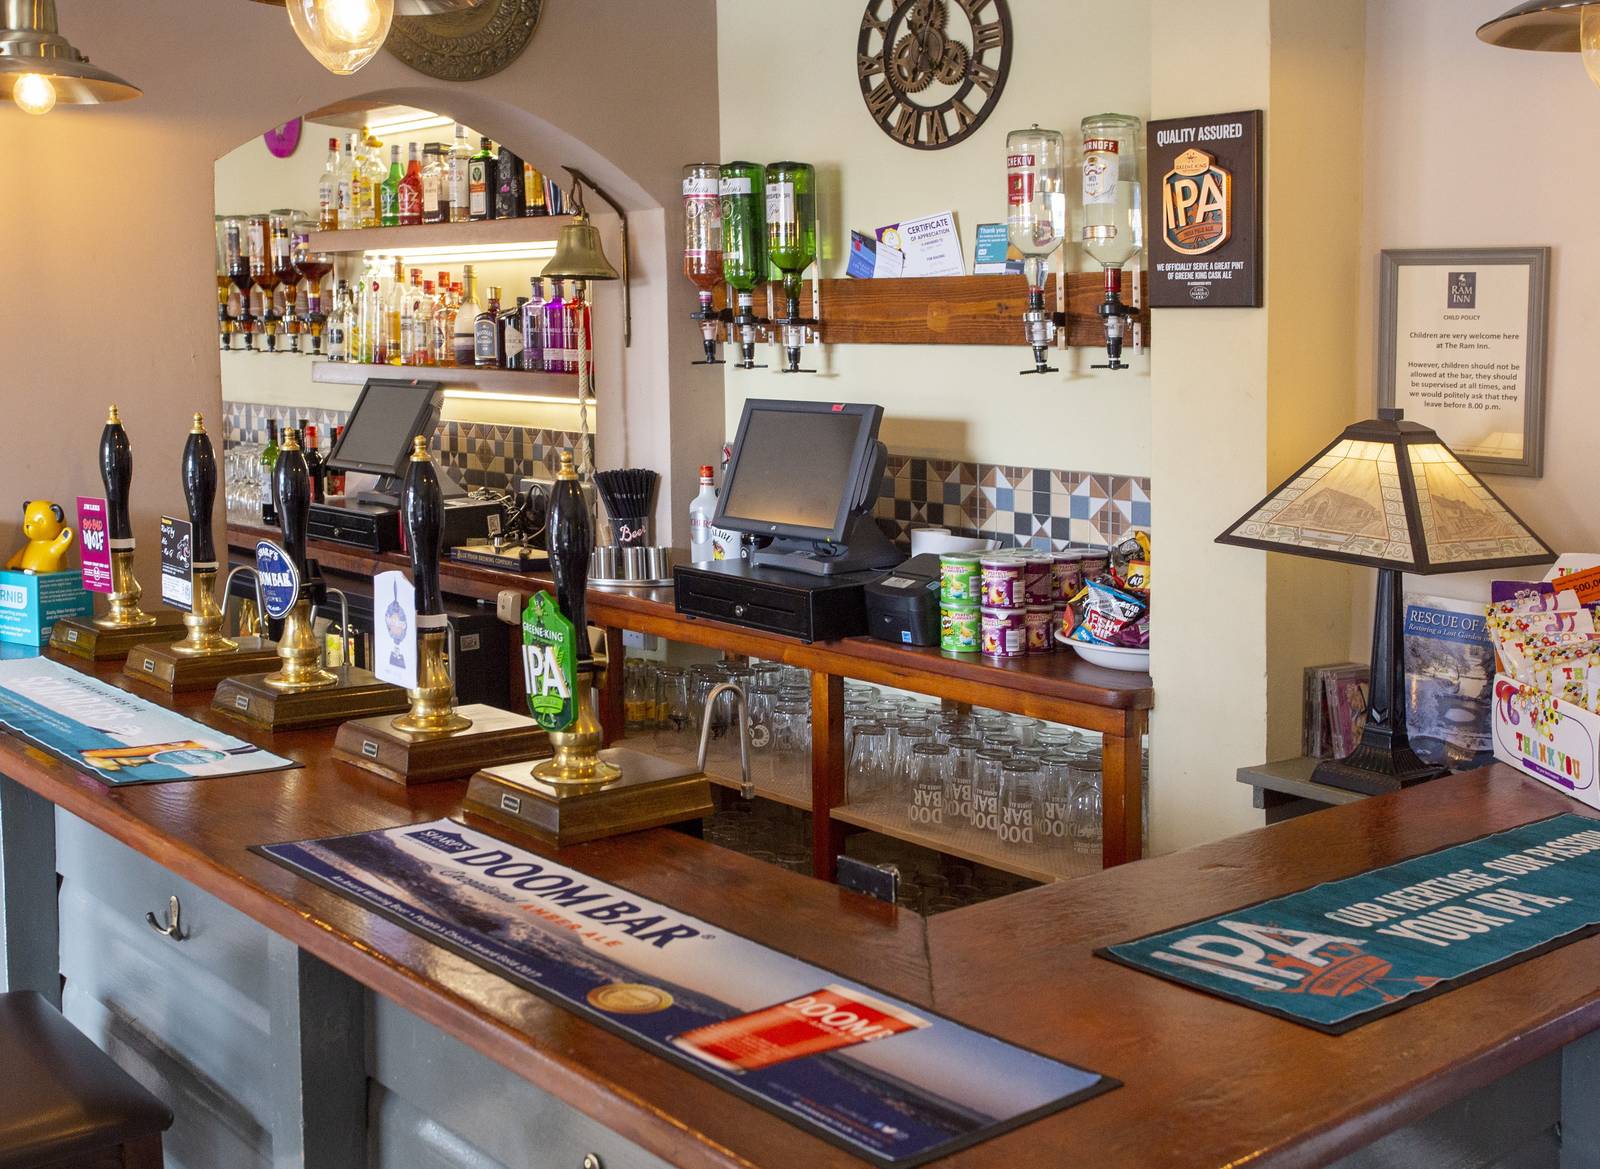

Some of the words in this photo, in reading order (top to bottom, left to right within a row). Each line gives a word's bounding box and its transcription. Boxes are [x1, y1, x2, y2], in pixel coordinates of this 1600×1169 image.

[1157, 127, 1196, 147] QUALITY
[1198, 123, 1243, 142] ASSURED
[1165, 173, 1224, 230] IPA
[907, 219, 949, 235] CERTIFICATE
[917, 228, 950, 240] APPRECIATION
[1156, 263, 1165, 271] WE
[1165, 262, 1192, 271] OFFICIALLY
[1193, 262, 1209, 270] SERVE
[1214, 261, 1230, 270] GREAT
[1231, 261, 1244, 269] PINT
[1167, 272, 1174, 280] OF
[1175, 272, 1194, 280] GREENE
[1195, 271, 1207, 279] KING
[1208, 271, 1221, 279] CASK
[1222, 271, 1232, 279] ALE
[1451, 285, 1472, 295] RAM
[1453, 294, 1471, 303] INN
[1452, 333, 1467, 341] very
[1408, 361, 1440, 370] However,
[1441, 361, 1470, 369] children
[1471, 362, 1495, 370] should
[1460, 372, 1474, 380] bar,
[1475, 373, 1491, 381] they
[1421, 381, 1458, 389] supervised
[1478, 382, 1501, 391] times,
[1443, 391, 1470, 400] politely
[1501, 394, 1518, 402] they
[1484, 403, 1502, 411] p.m.
[82, 529, 105, 551] WOLF
[620, 524, 646, 542] Beer
[495, 558, 513, 566] COMPANY
[1410, 610, 1458, 628] RESCUE
[1461, 617, 1479, 631] OF
[1408, 623, 1436, 634] Restoring
[1443, 629, 1457, 637] Lost
[1458, 632, 1483, 641] Garden
[522, 645, 570, 699] IPA
[1516, 731, 1555, 768] THANK
[1558, 751, 1580, 780] YOU
[914, 789, 942, 807] BAR
[1002, 806, 1032, 826] BAR
[420, 831, 471, 850] SHARP'S
[452, 850, 612, 907] DOOM
[1325, 902, 1406, 928] OUR
[1374, 869, 1519, 911] HERITAGE,
[1482, 854, 1554, 875] OUR
[519, 903, 582, 931] AMBER
[580, 931, 624, 948] ALE
[1375, 904, 1513, 948] YOUR
[1464, 888, 1574, 924] IPA.
[389, 903, 411, 914] Beer
[469, 943, 498, 957] Award
[1150, 919, 1368, 991] IPA
[783, 996, 883, 1037] DOOM
